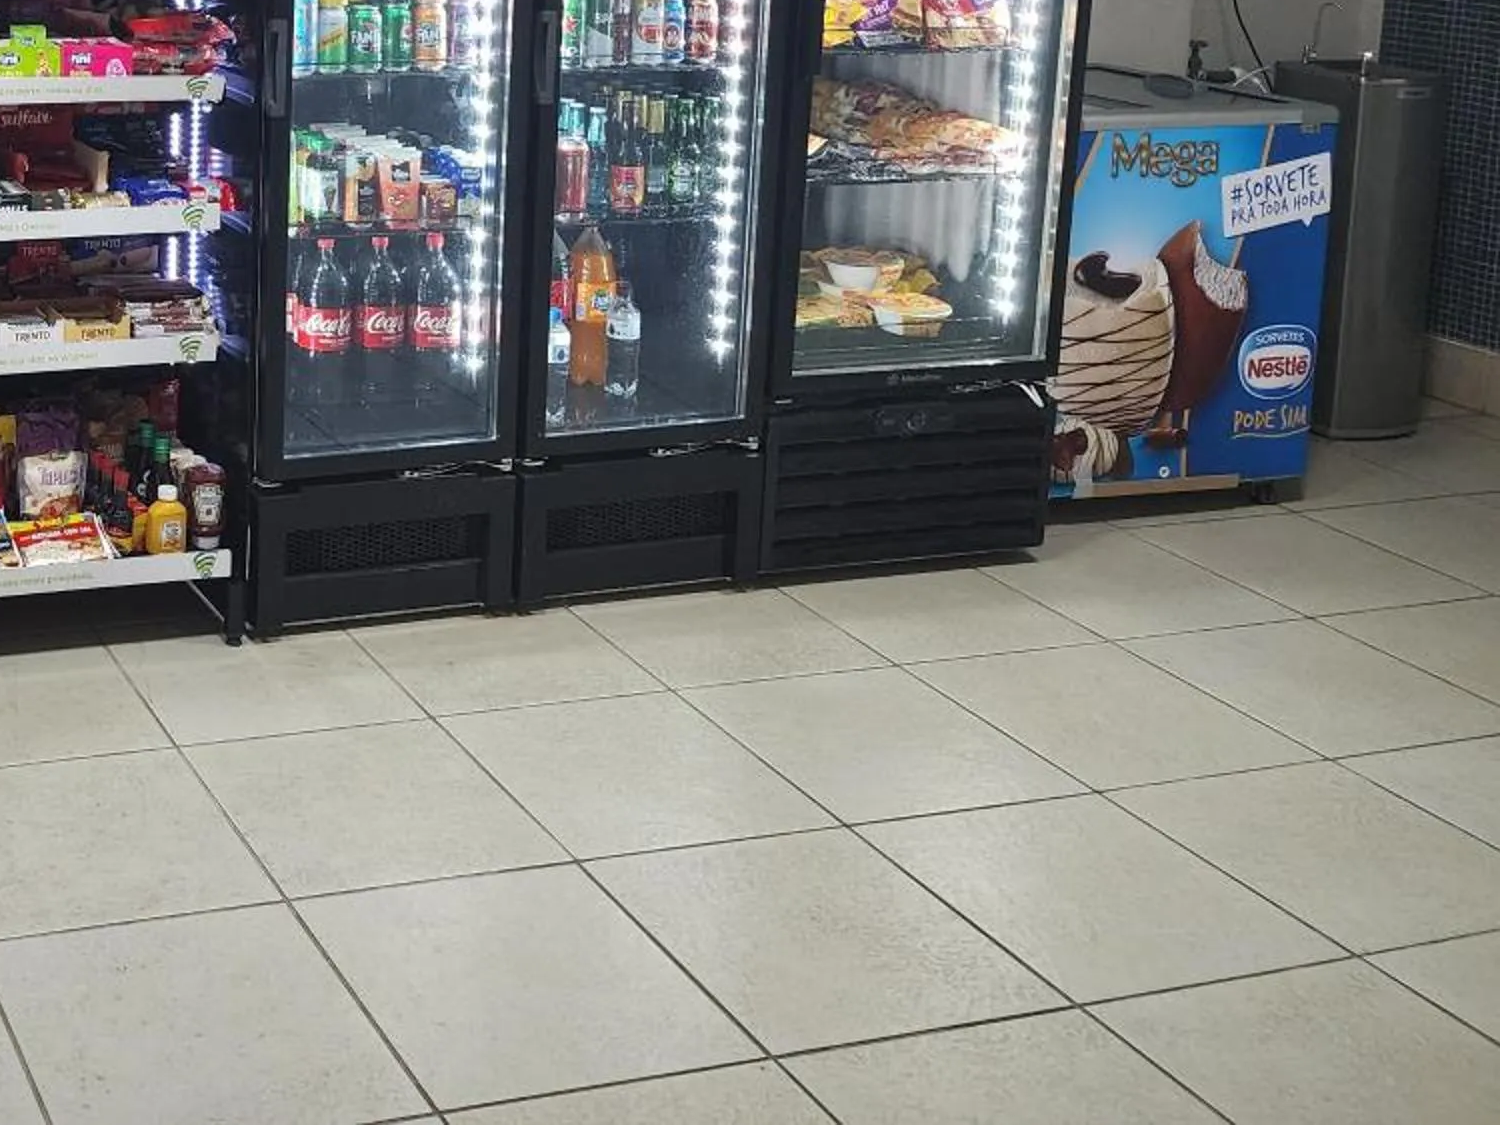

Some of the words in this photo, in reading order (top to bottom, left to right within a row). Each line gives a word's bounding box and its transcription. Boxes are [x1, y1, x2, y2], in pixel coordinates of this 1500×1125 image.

[1110, 131, 1220, 188] Mega
[1230, 163, 1320, 204] #SORVETE
[1231, 204, 1256, 229] PRA
[1259, 195, 1290, 218] TODA
[1293, 189, 1328, 212] HORA
[1247, 355, 1310, 380] Nestlé
[1233, 408, 1276, 432] PODE
